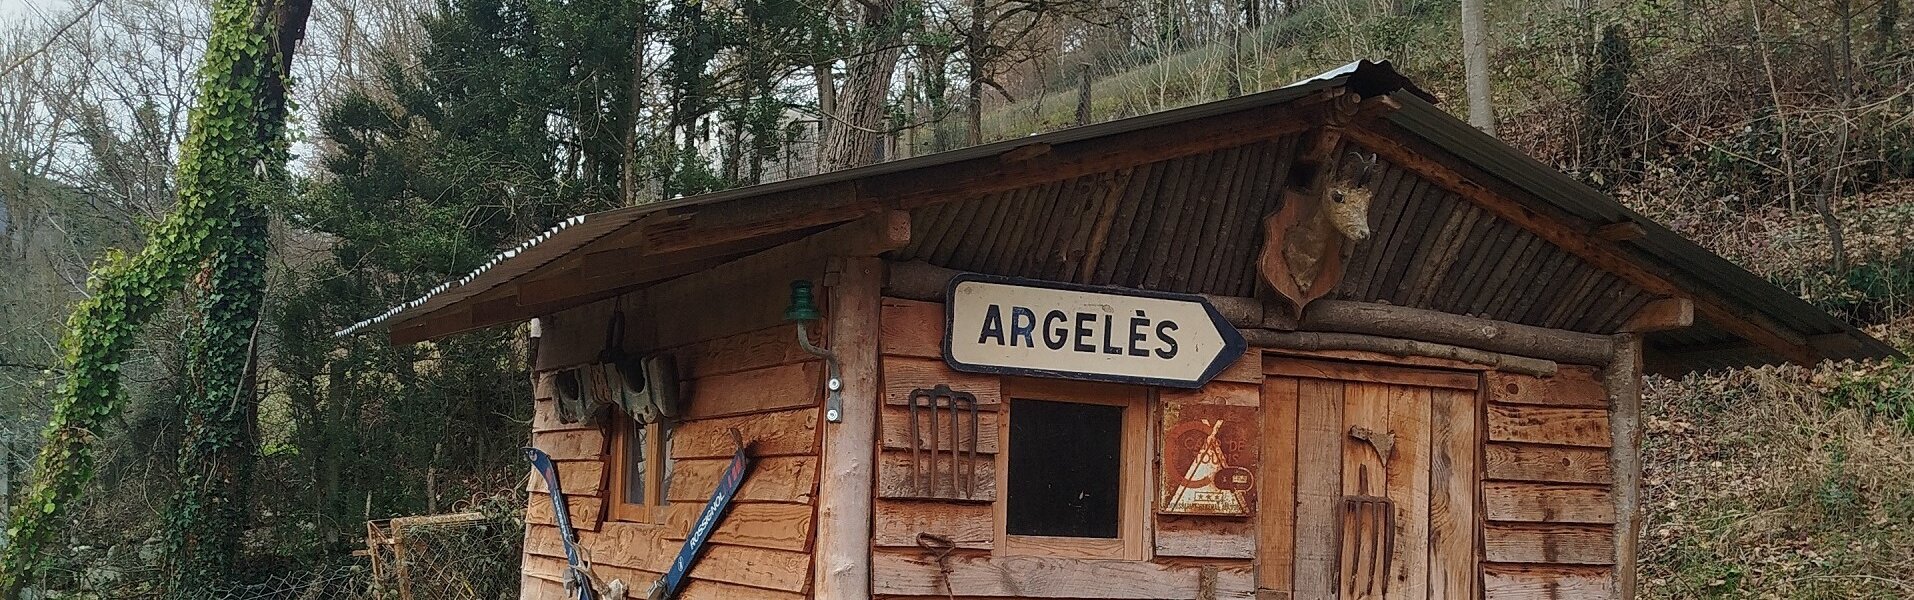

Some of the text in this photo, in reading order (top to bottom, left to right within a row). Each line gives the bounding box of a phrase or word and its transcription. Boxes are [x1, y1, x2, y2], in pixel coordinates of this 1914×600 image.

[978, 304, 1179, 360] ARGELÈS
[1229, 440, 1245, 452] DE
[689, 491, 725, 550] ROSSIGNOL
